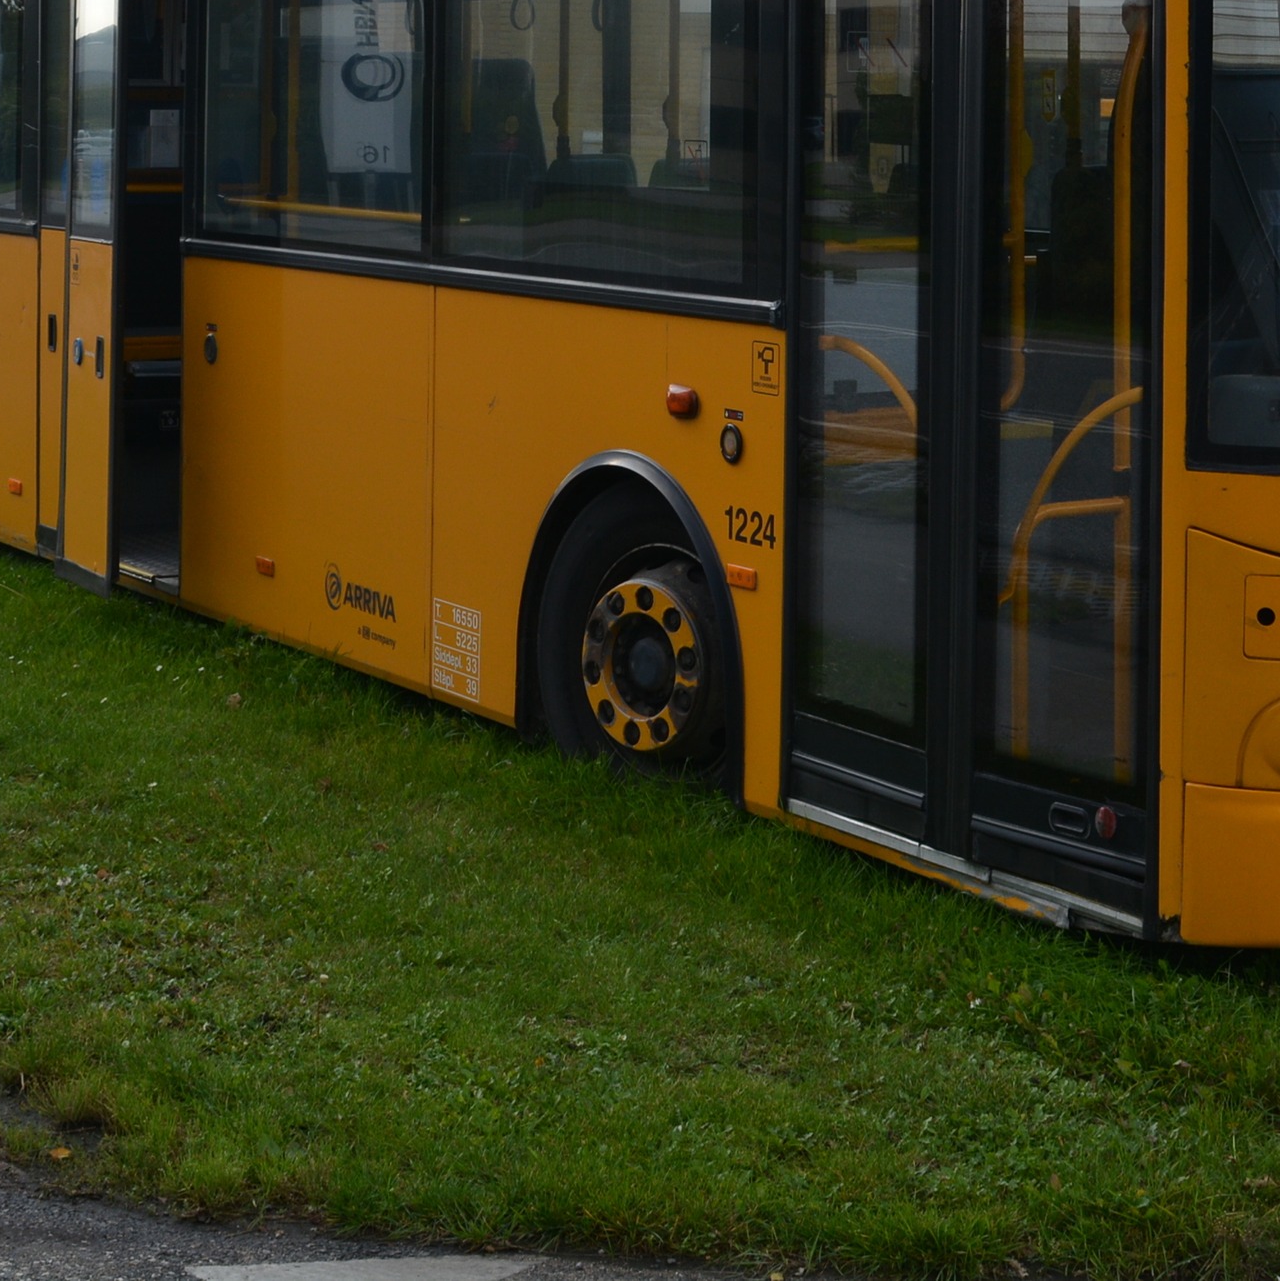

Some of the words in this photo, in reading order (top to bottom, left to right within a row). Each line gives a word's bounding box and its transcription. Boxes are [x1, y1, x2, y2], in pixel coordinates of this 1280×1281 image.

[725, 505, 776, 550] 1224
[343, 582, 397, 623] ARRIVA
[452, 607, 479, 630] 16550
[455, 631, 478, 653] 5225
[465, 656, 478, 674] 33
[465, 679, 477, 696] 39
